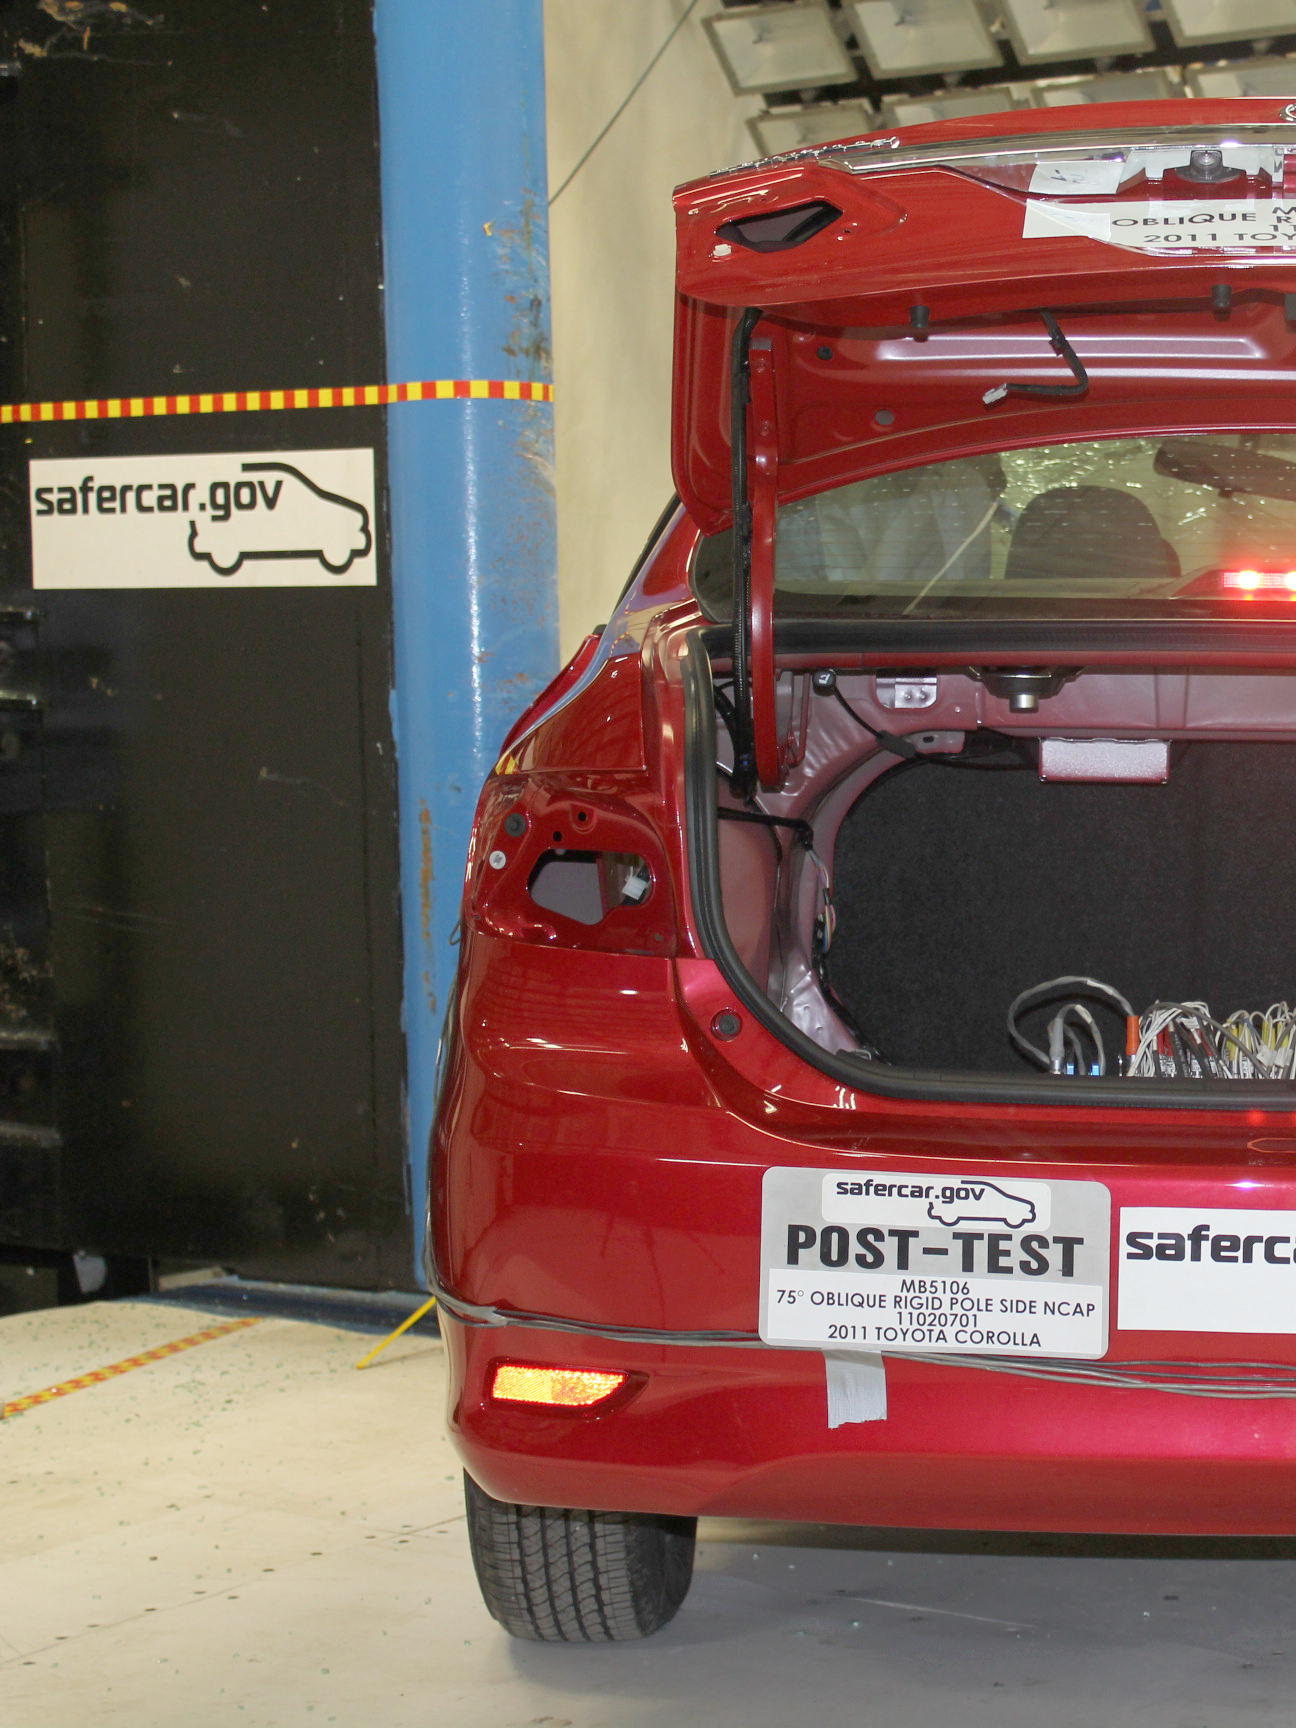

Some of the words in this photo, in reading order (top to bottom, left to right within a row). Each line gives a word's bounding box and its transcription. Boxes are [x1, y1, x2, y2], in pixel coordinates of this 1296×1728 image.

[1111, 212, 1257, 228] OBLIQUE
[1144, 233, 1219, 244] 2011
[35, 476, 284, 522] safercar.gov
[836, 1178, 986, 1204] safercar.gov
[786, 1223, 1085, 1278] POST-TEST
[899, 1278, 971, 1296] MB5106
[776, 1288, 805, 1305] 75°
[810, 1290, 887, 1310] OBLIQUE
[893, 1295, 943, 1311] RIGID
[949, 1297, 994, 1313] POLE
[999, 1299, 1037, 1315] SIDE
[1043, 1301, 1096, 1318] NCAP
[896, 1311, 979, 1328] 11020701
[828, 1324, 868, 1341] 2011
[874, 1327, 948, 1344] TOYOTA
[954, 1330, 1042, 1348] COROLLA
